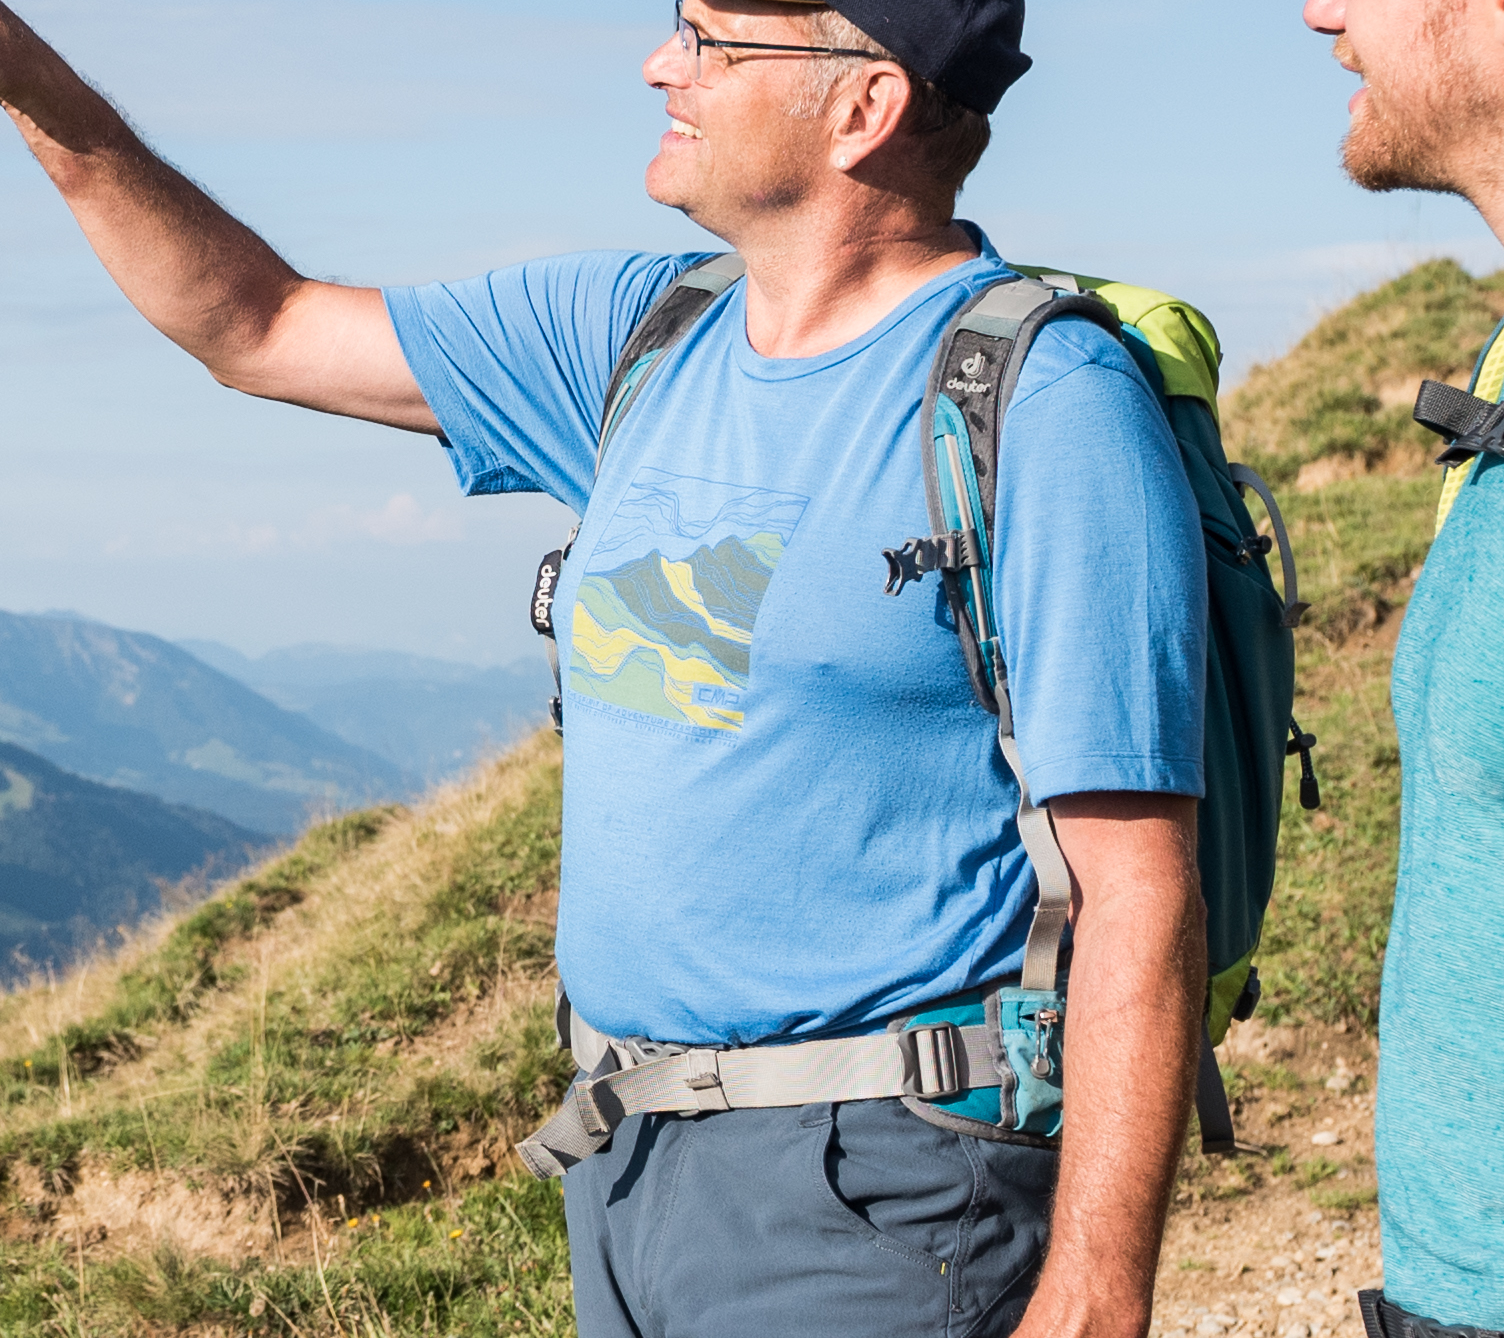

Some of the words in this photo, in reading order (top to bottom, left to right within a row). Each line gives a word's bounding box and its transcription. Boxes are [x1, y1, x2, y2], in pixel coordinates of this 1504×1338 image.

[945, 377, 992, 394] deuter
[535, 563, 557, 629] deuter
[697, 686, 740, 706] CMP
[615, 707, 670, 728] ADVENTURE
